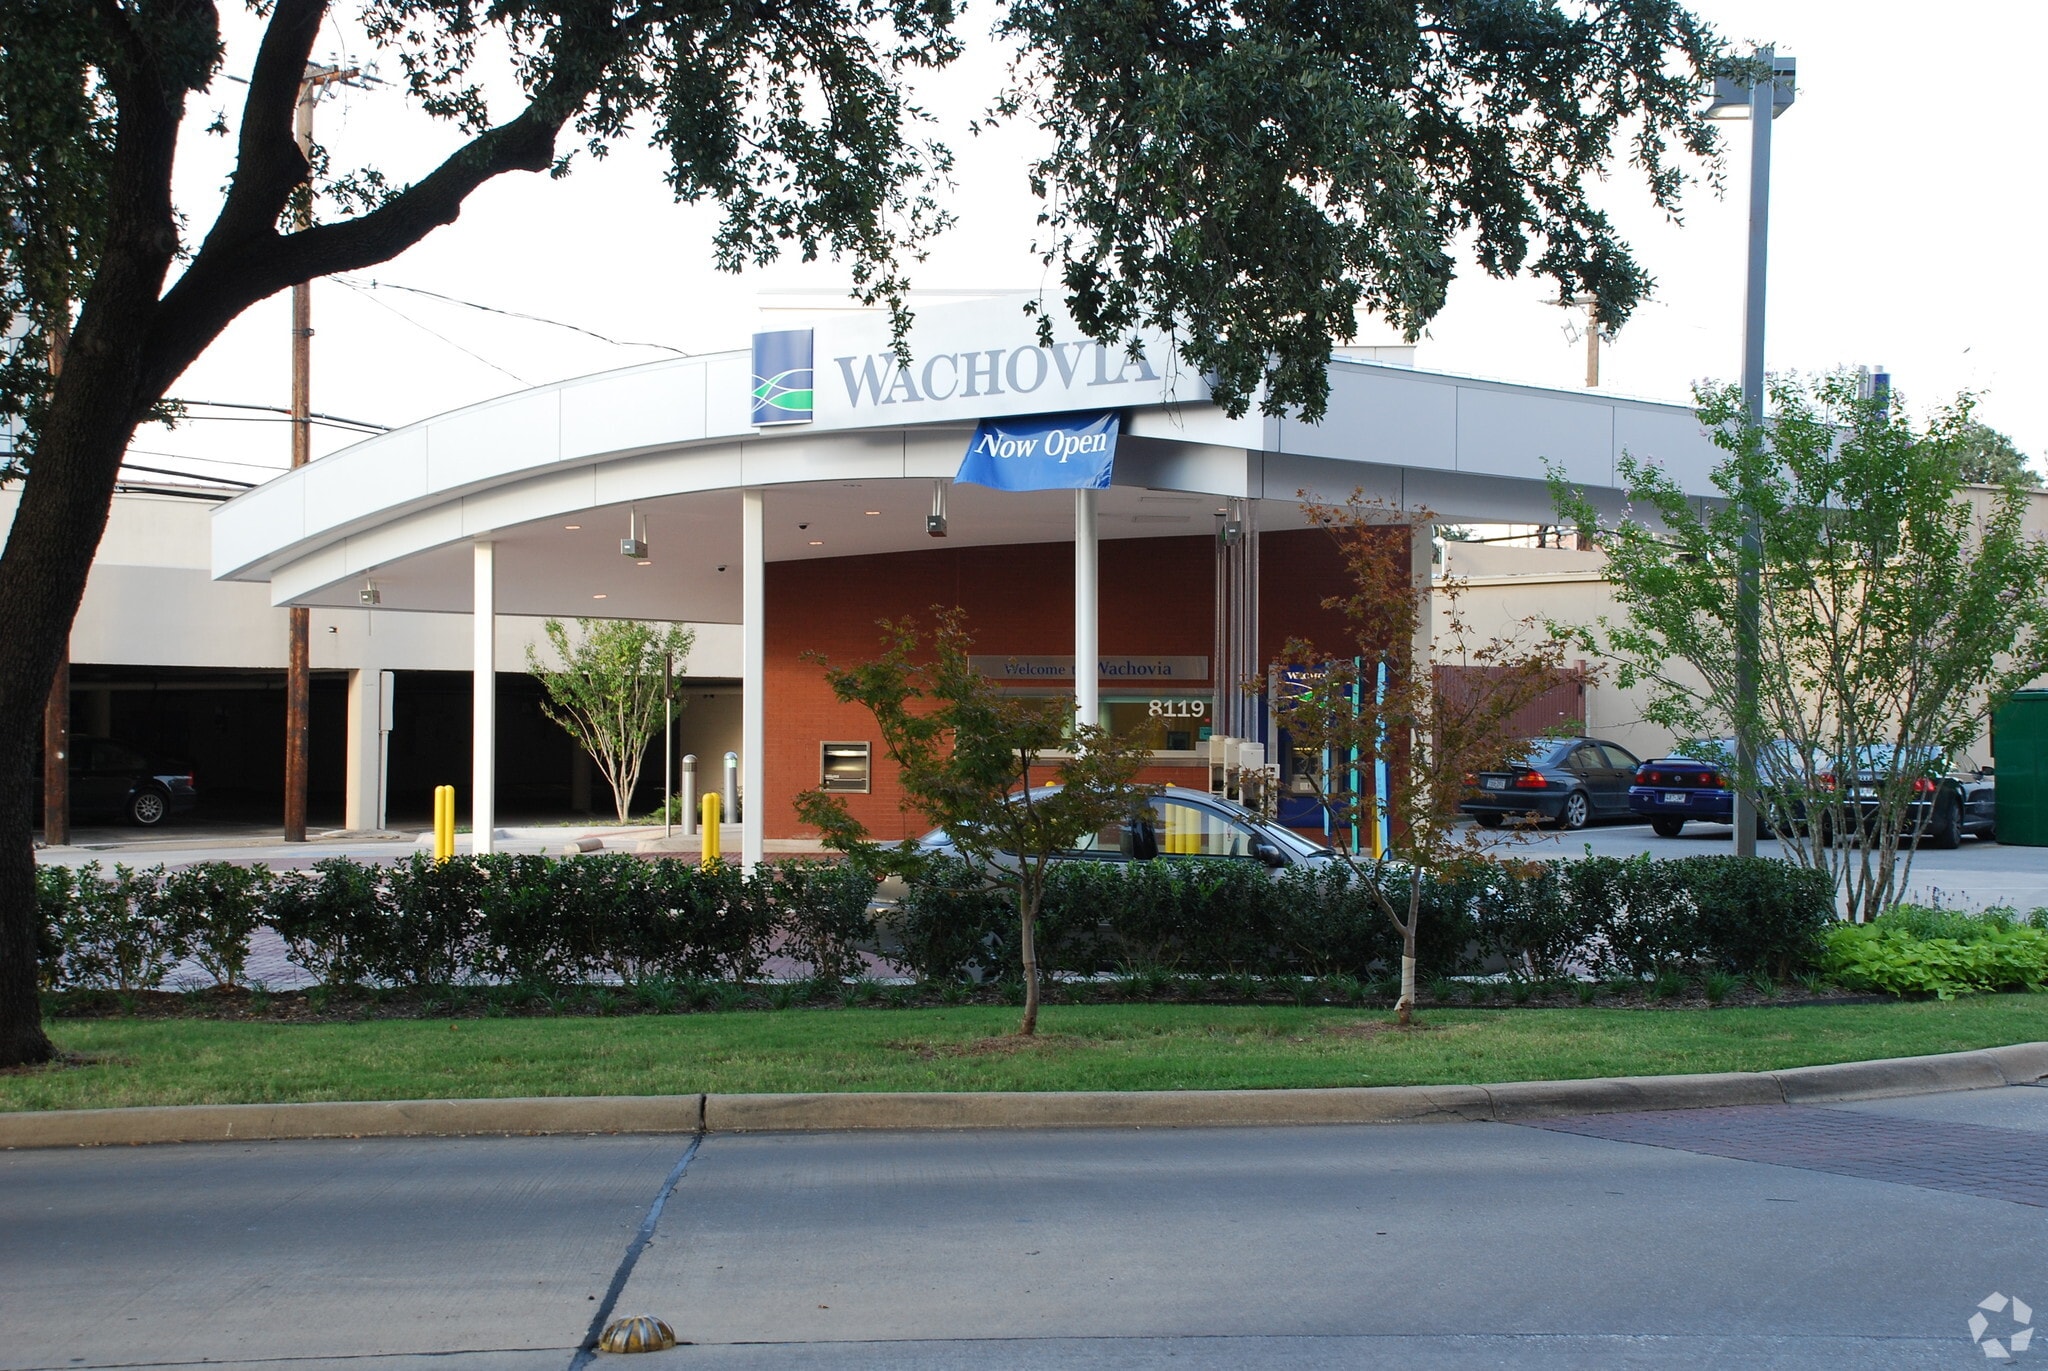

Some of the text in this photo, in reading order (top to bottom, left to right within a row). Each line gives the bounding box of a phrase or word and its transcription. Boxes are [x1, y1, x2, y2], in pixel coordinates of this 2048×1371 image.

[834, 336, 1160, 408] WACHOVIA
[974, 430, 1107, 464] Now Open
[1005, 663, 1066, 676] Welcome
[1148, 699, 1205, 718] 8119
